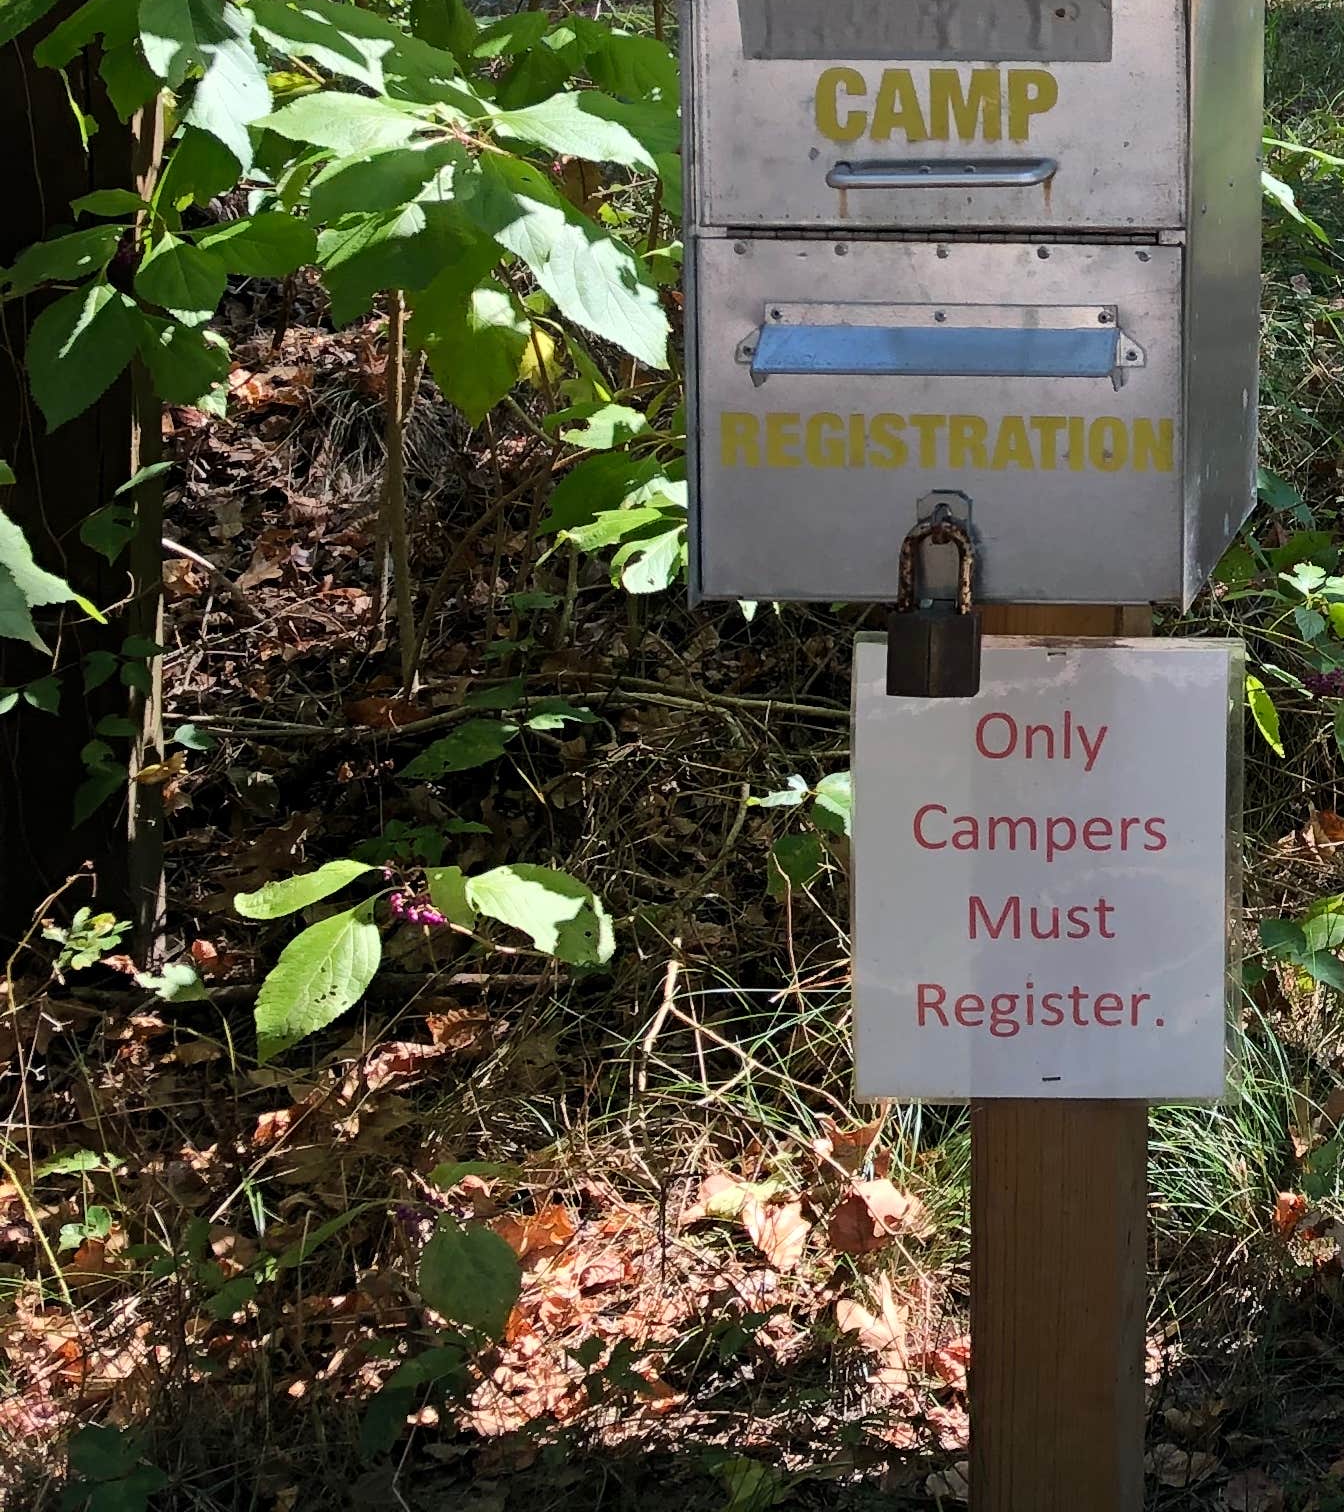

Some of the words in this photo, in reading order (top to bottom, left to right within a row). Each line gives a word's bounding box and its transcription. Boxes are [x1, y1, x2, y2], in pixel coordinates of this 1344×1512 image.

[814, 67, 1059, 144] CAMP
[719, 411, 1174, 473] REGISTRATION
[976, 710, 1109, 772] Only
[913, 804, 1169, 863] Campers
[968, 895, 1116, 940] Must
[916, 982, 1165, 1038] Register.
